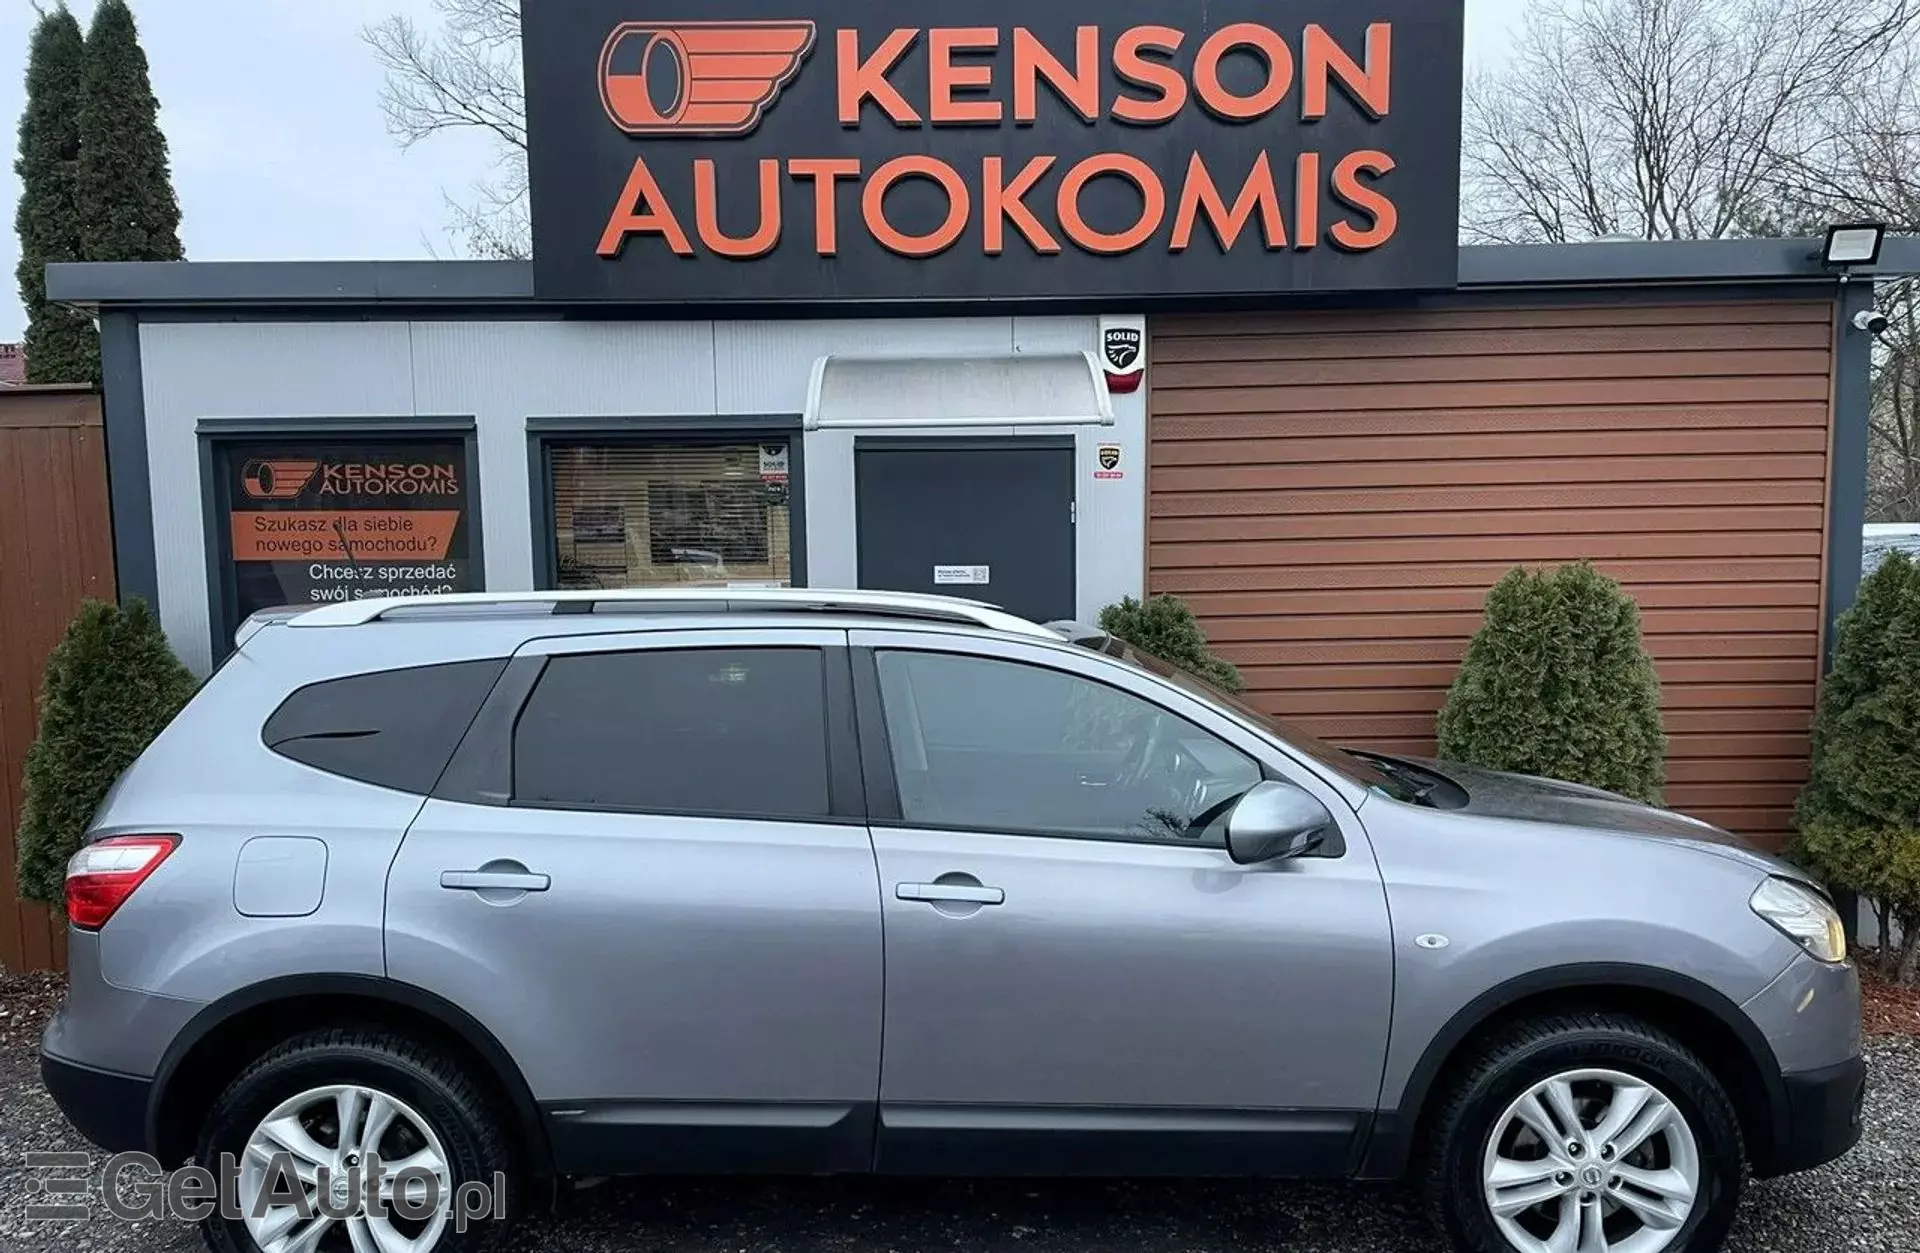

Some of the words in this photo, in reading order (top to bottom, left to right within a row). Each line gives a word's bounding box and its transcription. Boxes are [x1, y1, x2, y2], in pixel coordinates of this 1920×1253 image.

[837, 22, 1393, 126] KENSON
[595, 149, 1398, 257] AUTOKOMIS
[1106, 331, 1139, 342] SOLID
[322, 463, 454, 479] KENSON
[319, 478, 459, 495] AUTOKOMIS
[254, 516, 326, 532] Szukasz
[364, 516, 413, 532] siebie
[256, 540, 323, 555] nowego
[328, 536, 437, 551] samochodu?
[378, 563, 456, 582] sprzedać
[310, 585, 348, 601] swój
[353, 585, 453, 600] smochód
